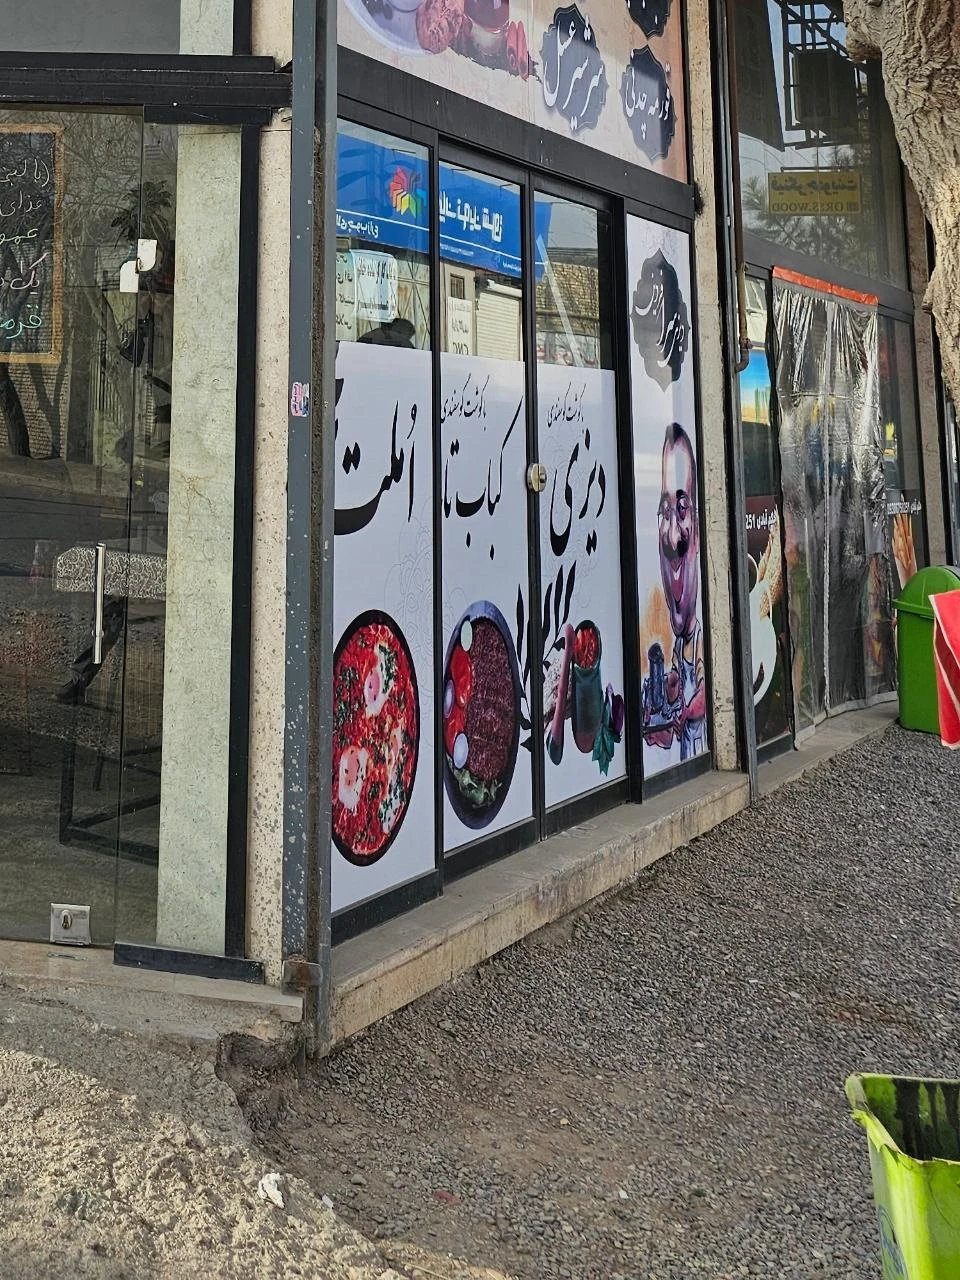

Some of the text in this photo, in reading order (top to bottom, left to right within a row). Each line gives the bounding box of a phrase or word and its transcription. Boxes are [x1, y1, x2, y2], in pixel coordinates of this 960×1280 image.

[543, 19, 577, 108] عسل
[456, 395, 524, 561] کباب
[549, 427, 606, 557] دیزی
